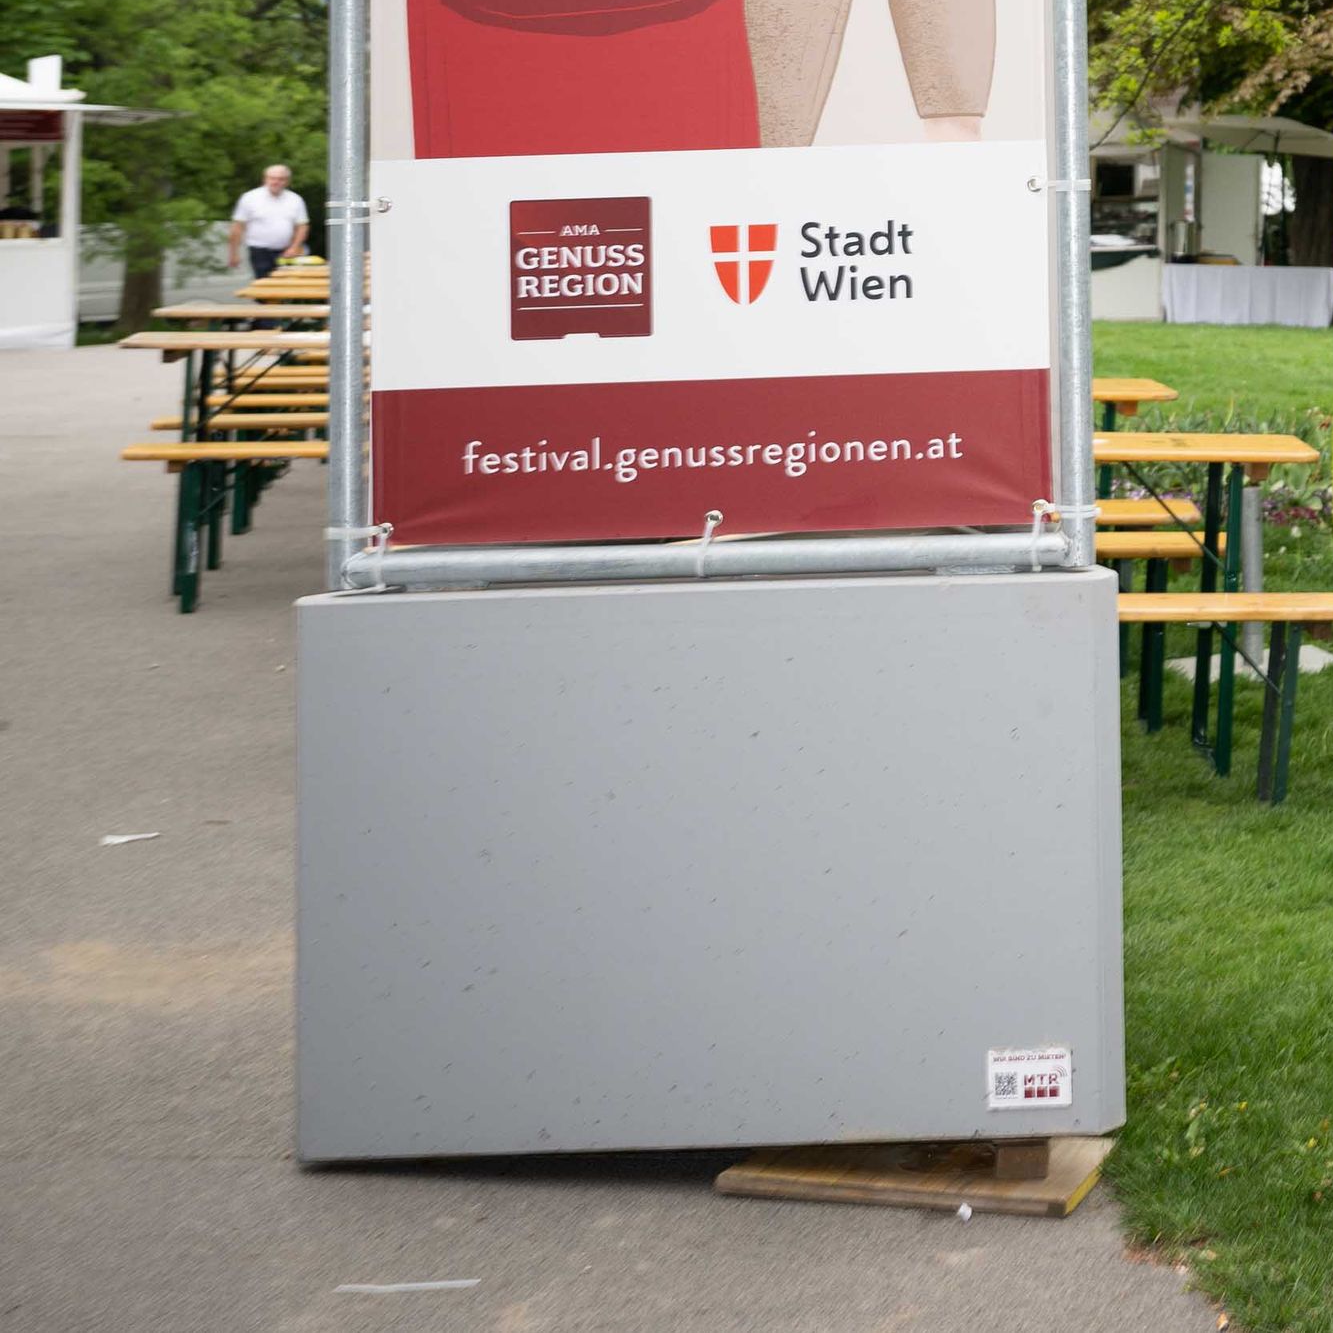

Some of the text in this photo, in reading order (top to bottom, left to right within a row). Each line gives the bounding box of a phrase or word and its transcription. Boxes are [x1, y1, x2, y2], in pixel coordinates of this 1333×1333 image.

[560, 224, 600, 236] AMA
[800, 220, 912, 258] Stadt
[515, 244, 644, 269] GENUSS
[516, 272, 642, 298] REGION
[800, 265, 912, 302] Wien
[463, 430, 963, 483] festival.genussregionen.at
[1024, 1073, 1059, 1085] MTR
